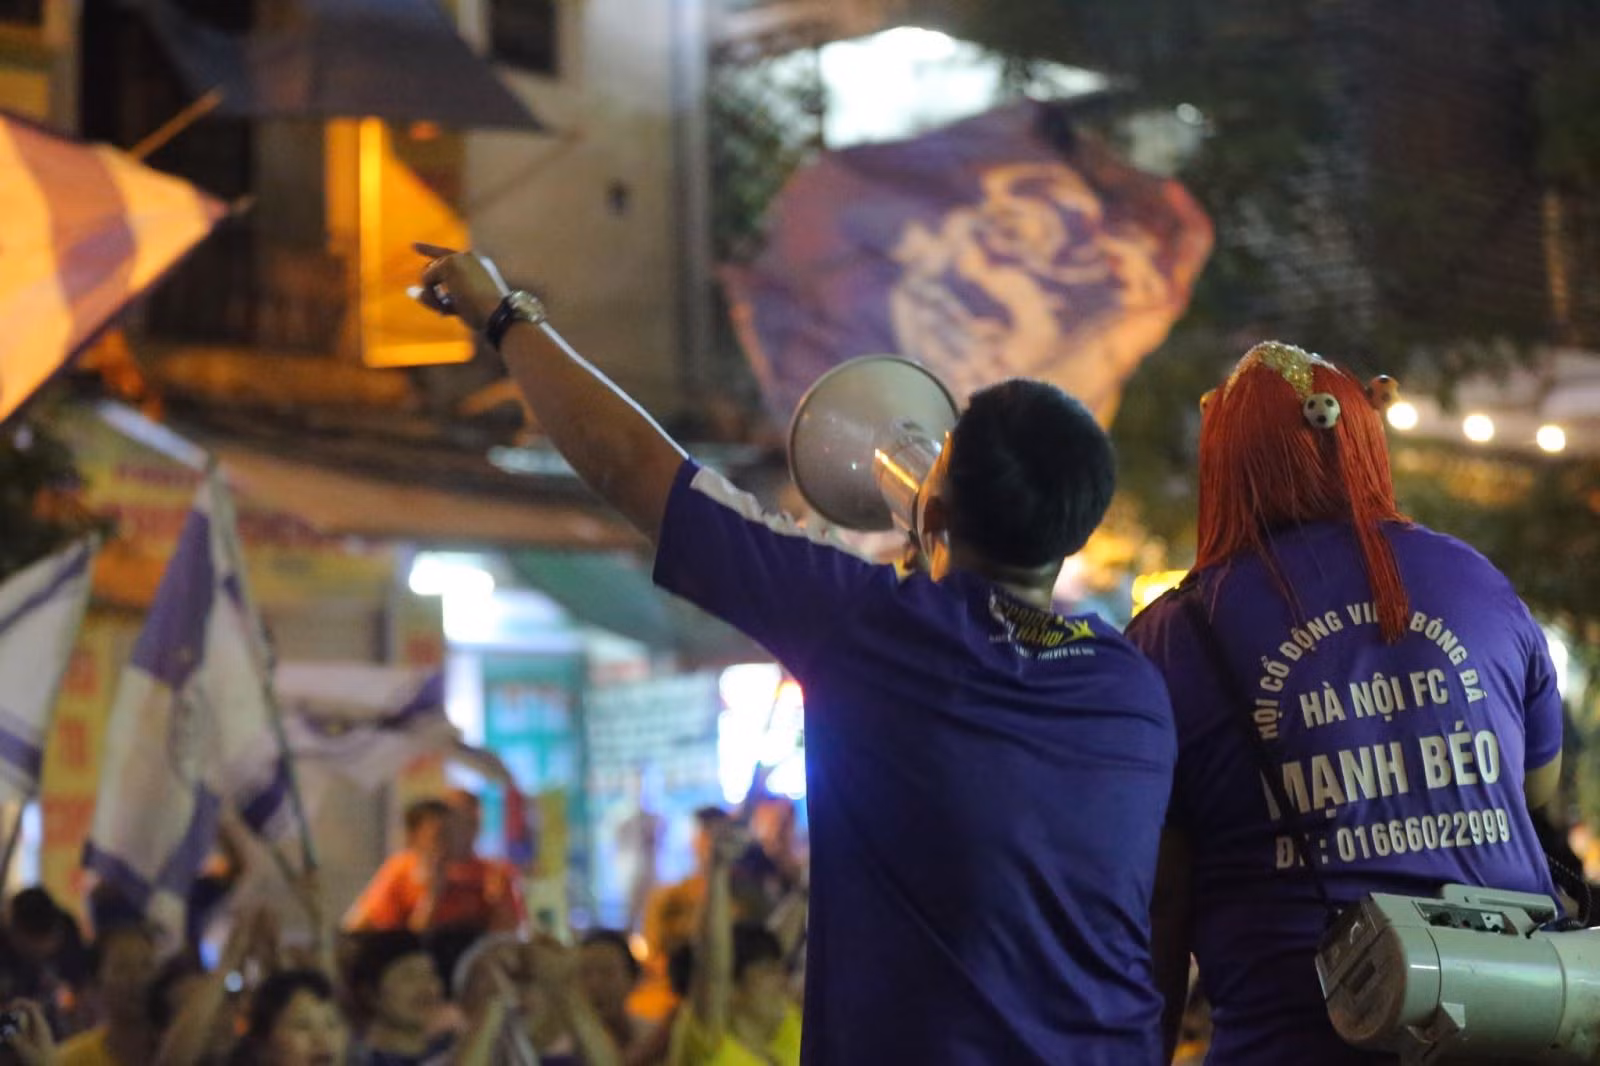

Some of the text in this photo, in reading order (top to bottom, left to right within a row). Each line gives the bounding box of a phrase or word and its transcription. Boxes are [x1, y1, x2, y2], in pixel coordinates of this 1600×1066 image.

[1279, 610, 1344, 661] ĐỘNG
[1347, 602, 1379, 625] VI
[1409, 611, 1467, 666] BÓNG
[1459, 669, 1488, 704] ĐÁ
[1299, 668, 1449, 728] HÀ NỘI FC
[1419, 720, 1500, 789] BÉO
[1336, 808, 1511, 863] 01666022999
